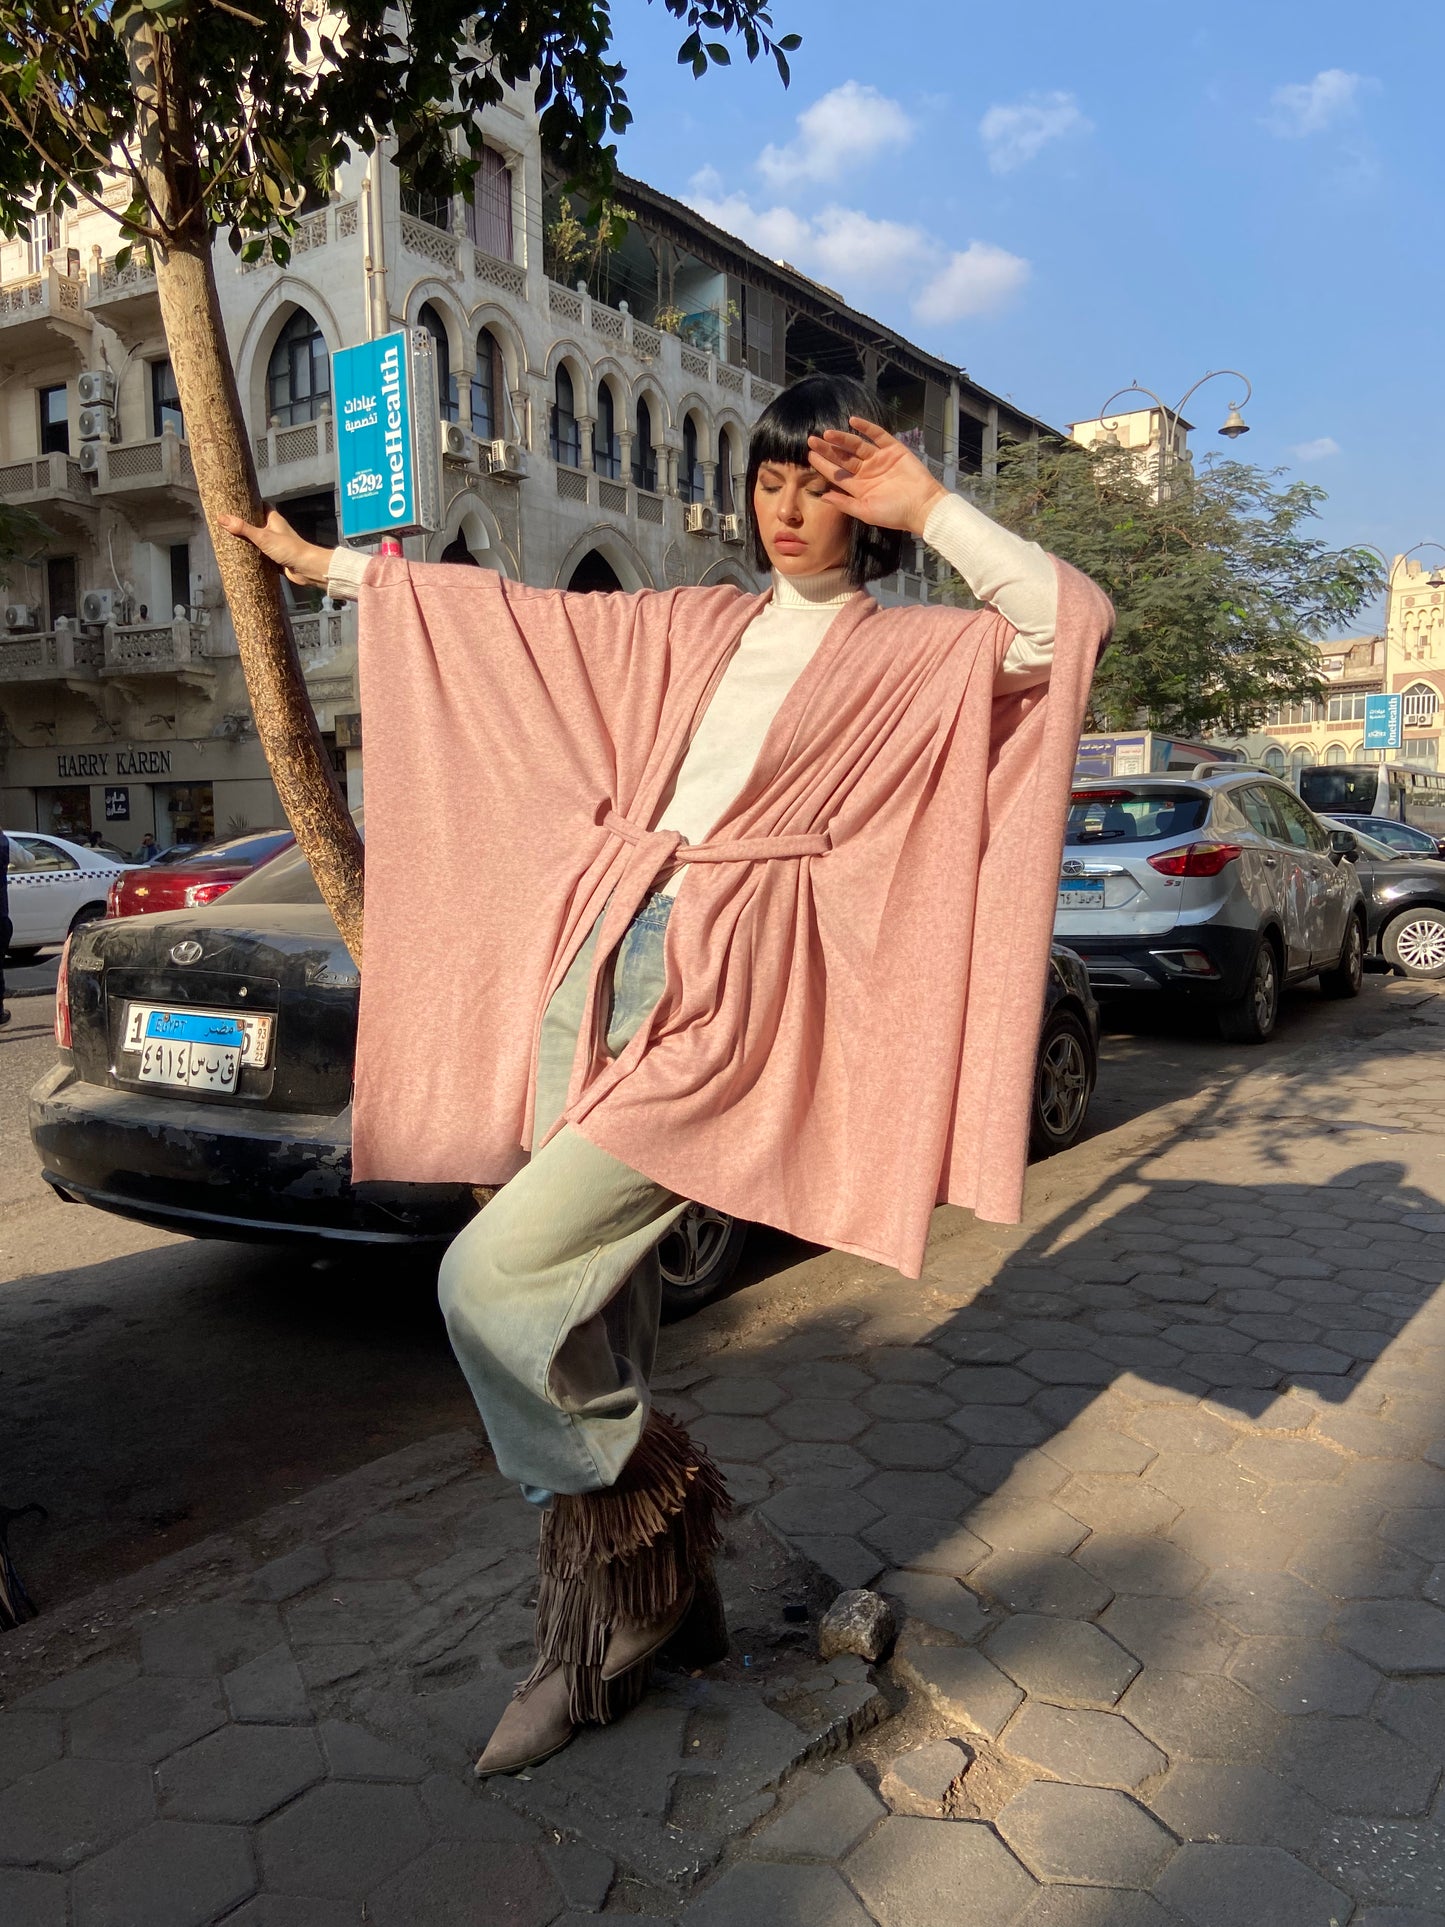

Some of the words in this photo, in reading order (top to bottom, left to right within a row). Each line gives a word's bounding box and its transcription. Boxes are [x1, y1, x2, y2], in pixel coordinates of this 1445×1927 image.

[344, 394, 377, 414] عيادات
[345, 412, 378, 433] تخصصية
[380, 345, 406, 519] OneHealth
[346, 473, 383, 497] 15292
[1387, 697, 1398, 745] OneHealth
[57, 753, 108, 778] HARRY
[116, 750, 172, 775] KAREN
[155, 1018, 188, 1035] EGYPT
[204, 1021, 234, 1037] مصر
[256, 1028, 267, 1039] 93
[255, 1041, 265, 1051] 20
[254, 1052, 264, 1062] 22
